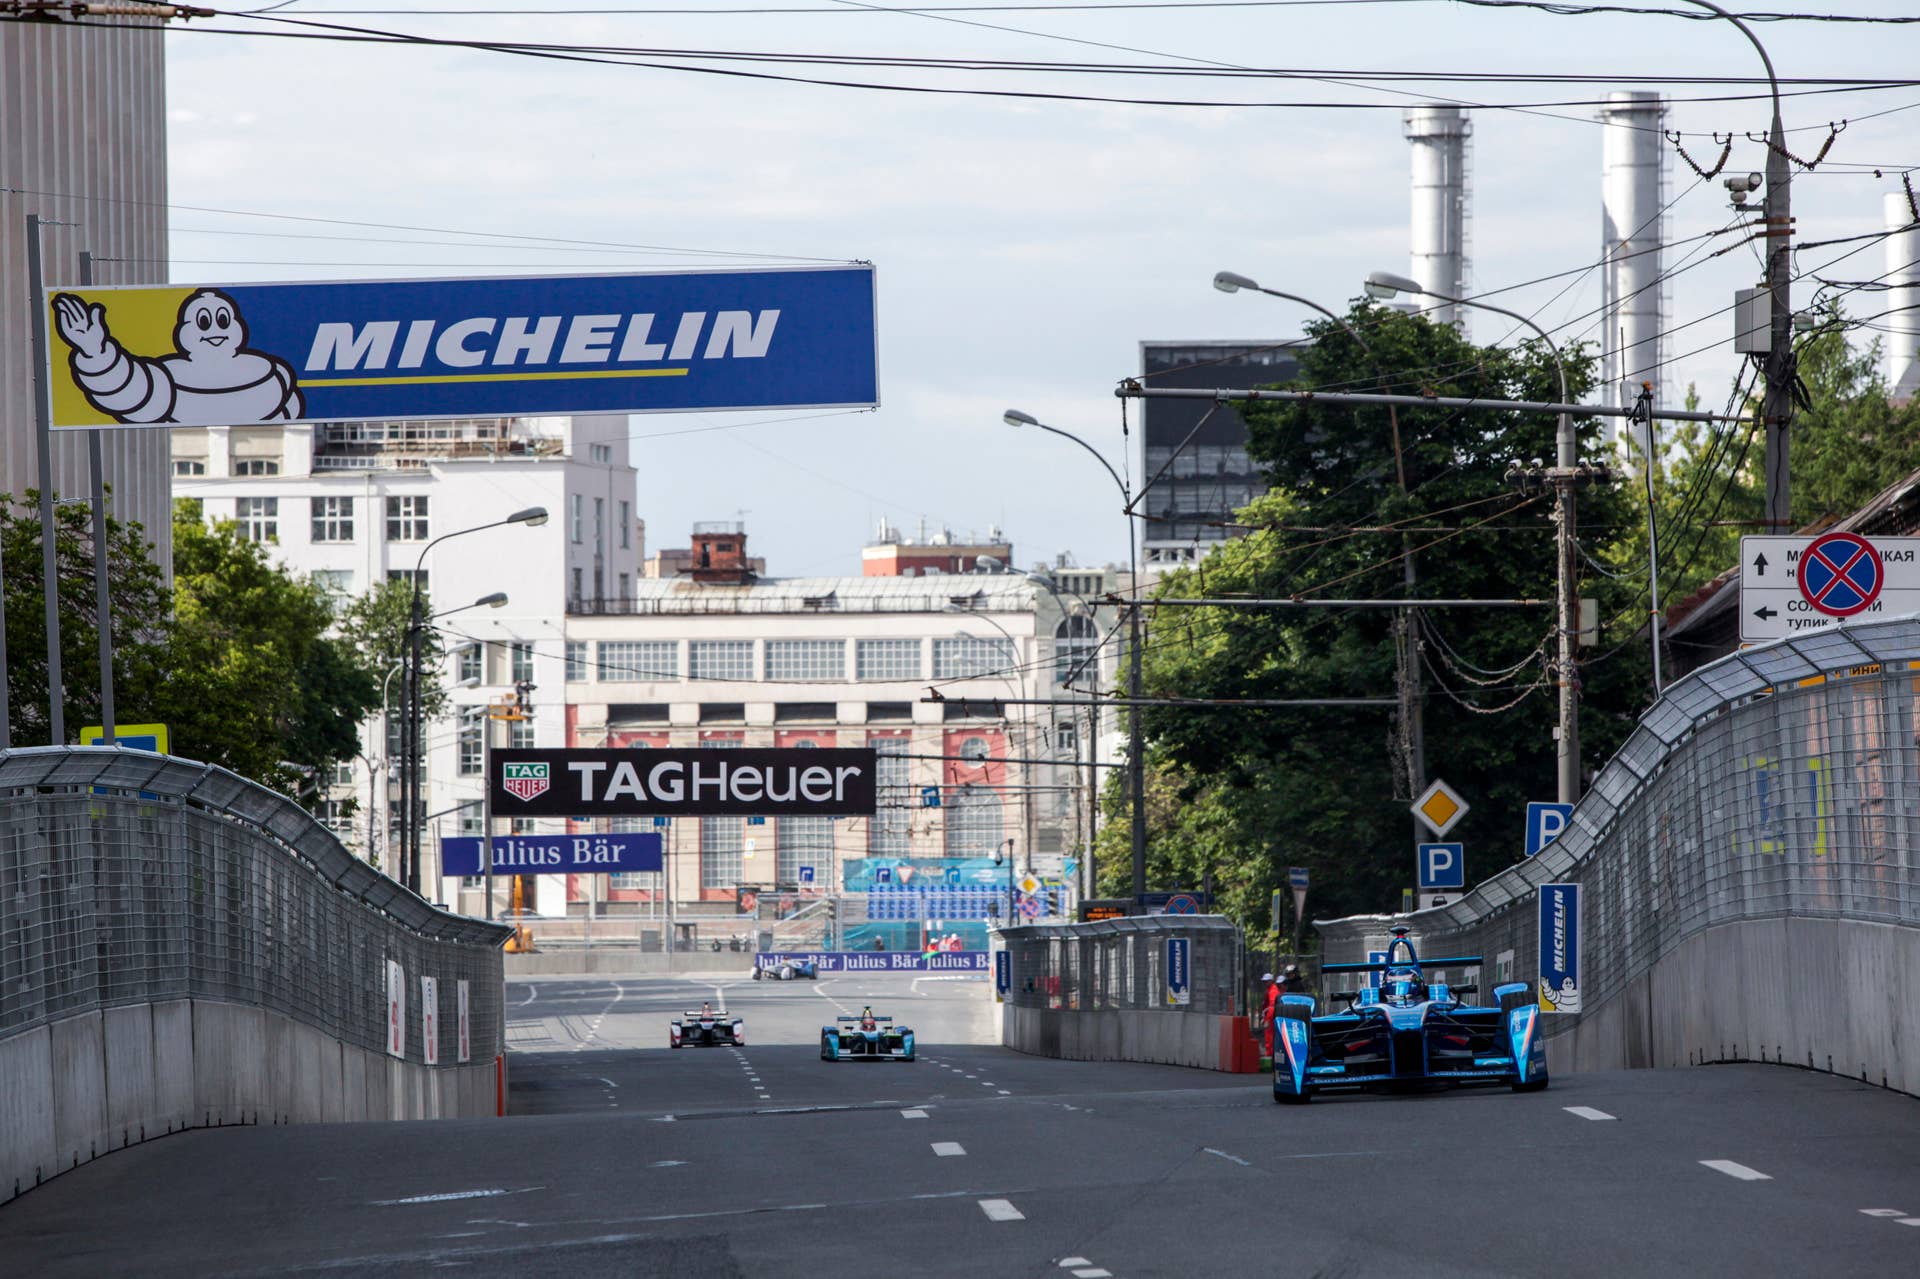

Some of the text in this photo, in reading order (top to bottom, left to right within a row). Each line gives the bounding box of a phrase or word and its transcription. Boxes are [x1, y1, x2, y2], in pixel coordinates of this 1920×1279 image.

[304, 309, 781, 373] MICHELIN
[1786, 618, 1829, 630] тупик
[507, 765, 546, 777] TAG
[505, 778, 548, 799] HEUER
[476, 838, 627, 873] Julius Bär
[1428, 848, 1453, 883] P
[1553, 890, 1565, 973] MICHELIN
[842, 954, 887, 972] Julius
[891, 953, 921, 969] Bär
[926, 954, 971, 971] Julius
